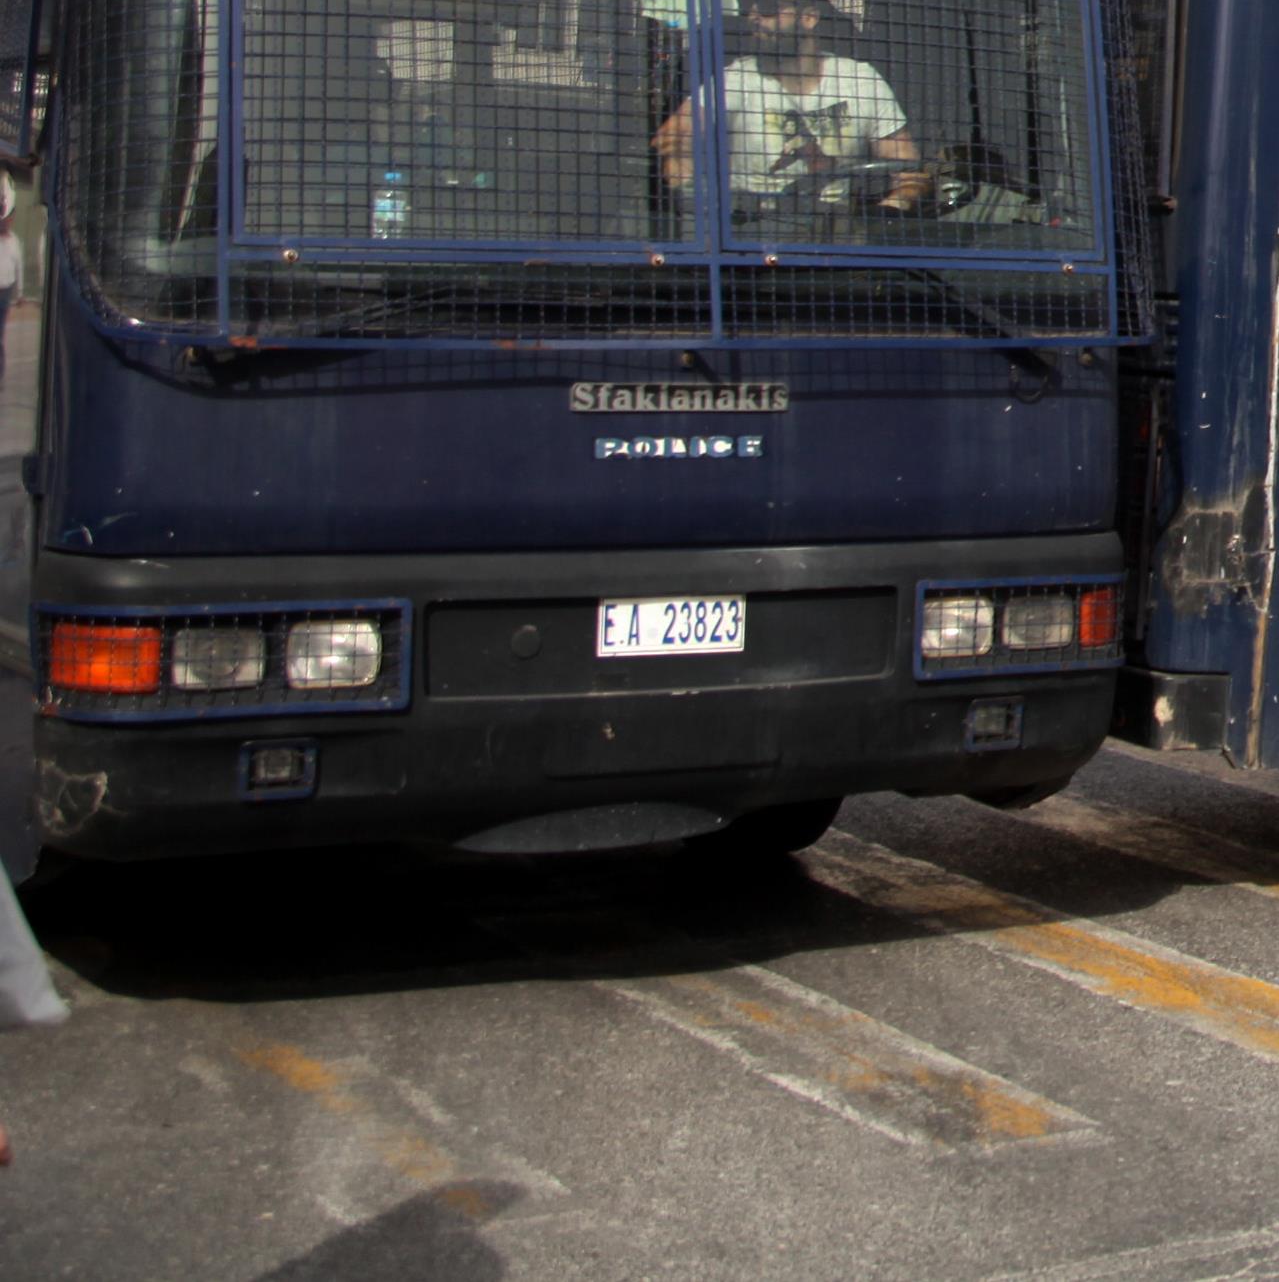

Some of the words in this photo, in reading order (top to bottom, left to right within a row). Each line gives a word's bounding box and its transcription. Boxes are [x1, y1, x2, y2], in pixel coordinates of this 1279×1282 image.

[572, 383, 788, 411] Sfakianakis
[594, 436, 763, 459] POLICE
[661, 600, 741, 645] 23823
